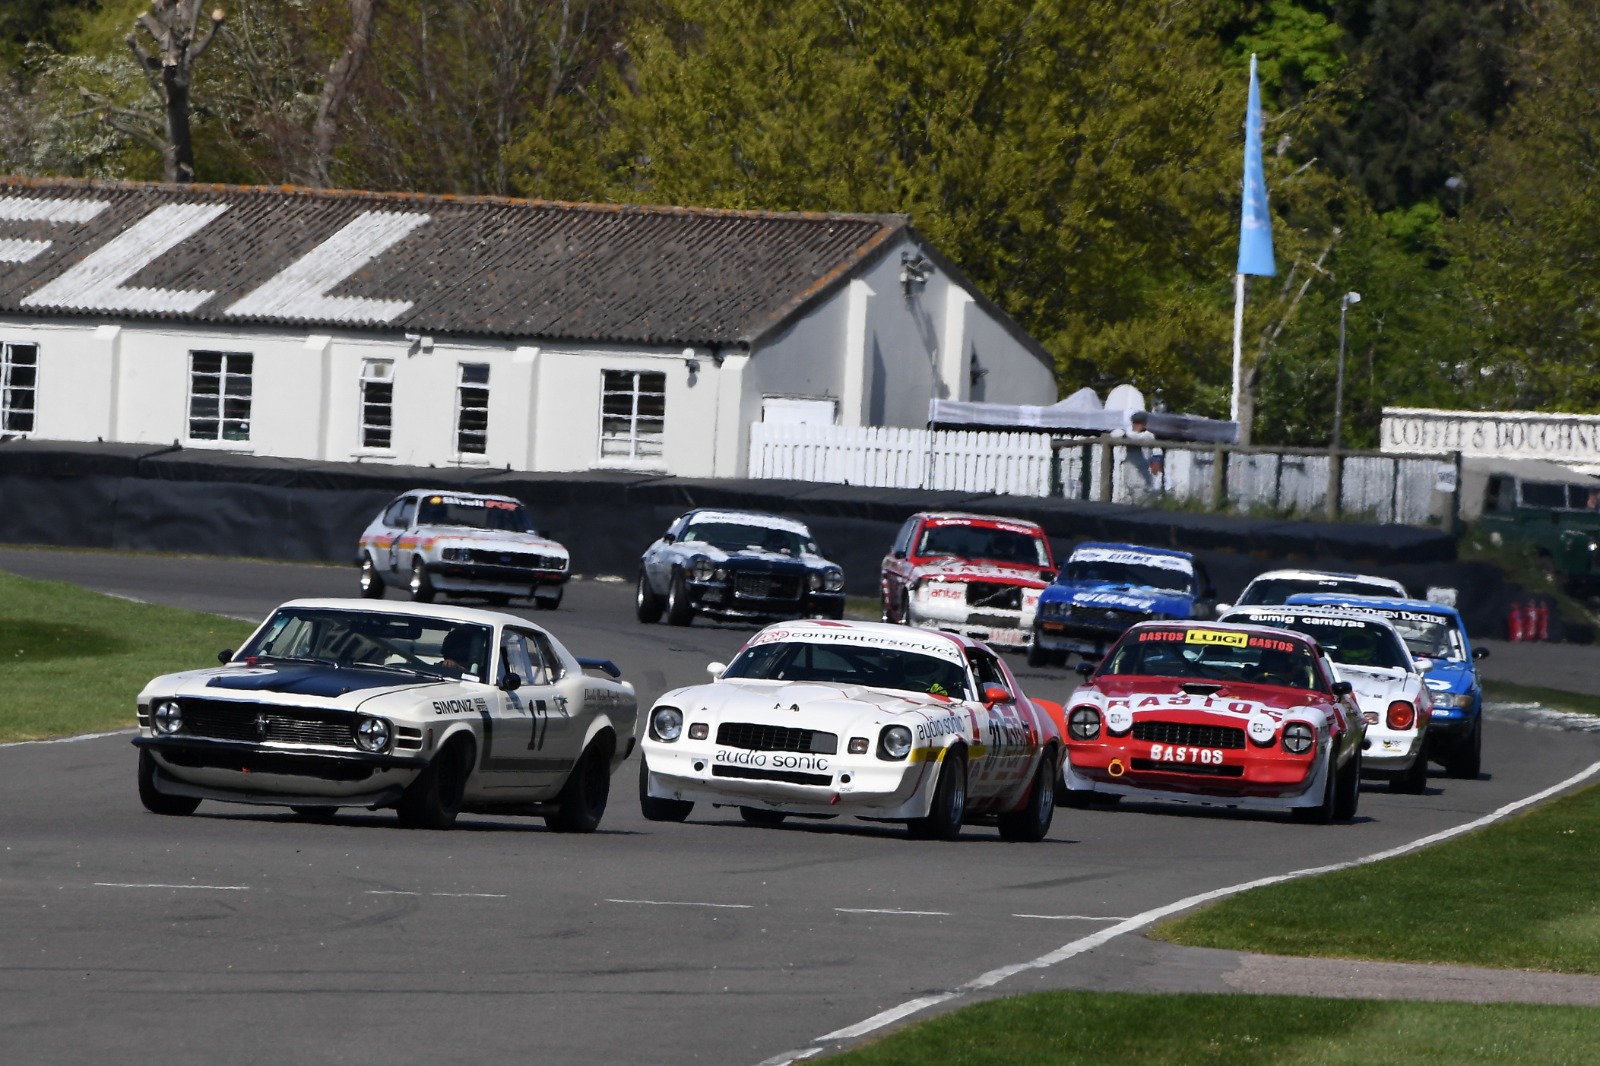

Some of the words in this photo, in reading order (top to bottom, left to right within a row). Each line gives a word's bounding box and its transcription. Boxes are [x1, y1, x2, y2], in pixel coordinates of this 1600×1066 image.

[0, 197, 431, 324] LL
[1249, 613, 1295, 624] eumig
[1302, 617, 1365, 628] cameras
[791, 631, 960, 659] computerservice
[1139, 632, 1184, 642] BASTOS
[1190, 634, 1244, 645] LUIGI
[1249, 638, 1294, 652] BASTOS
[432, 700, 474, 715] SIMONIZ
[527, 699, 549, 751] 17
[916, 717, 944, 740] audio
[943, 715, 966, 735] sonic
[715, 749, 767, 766] audio
[772, 751, 829, 771] sonic
[1150, 744, 1223, 765] BASTOS
